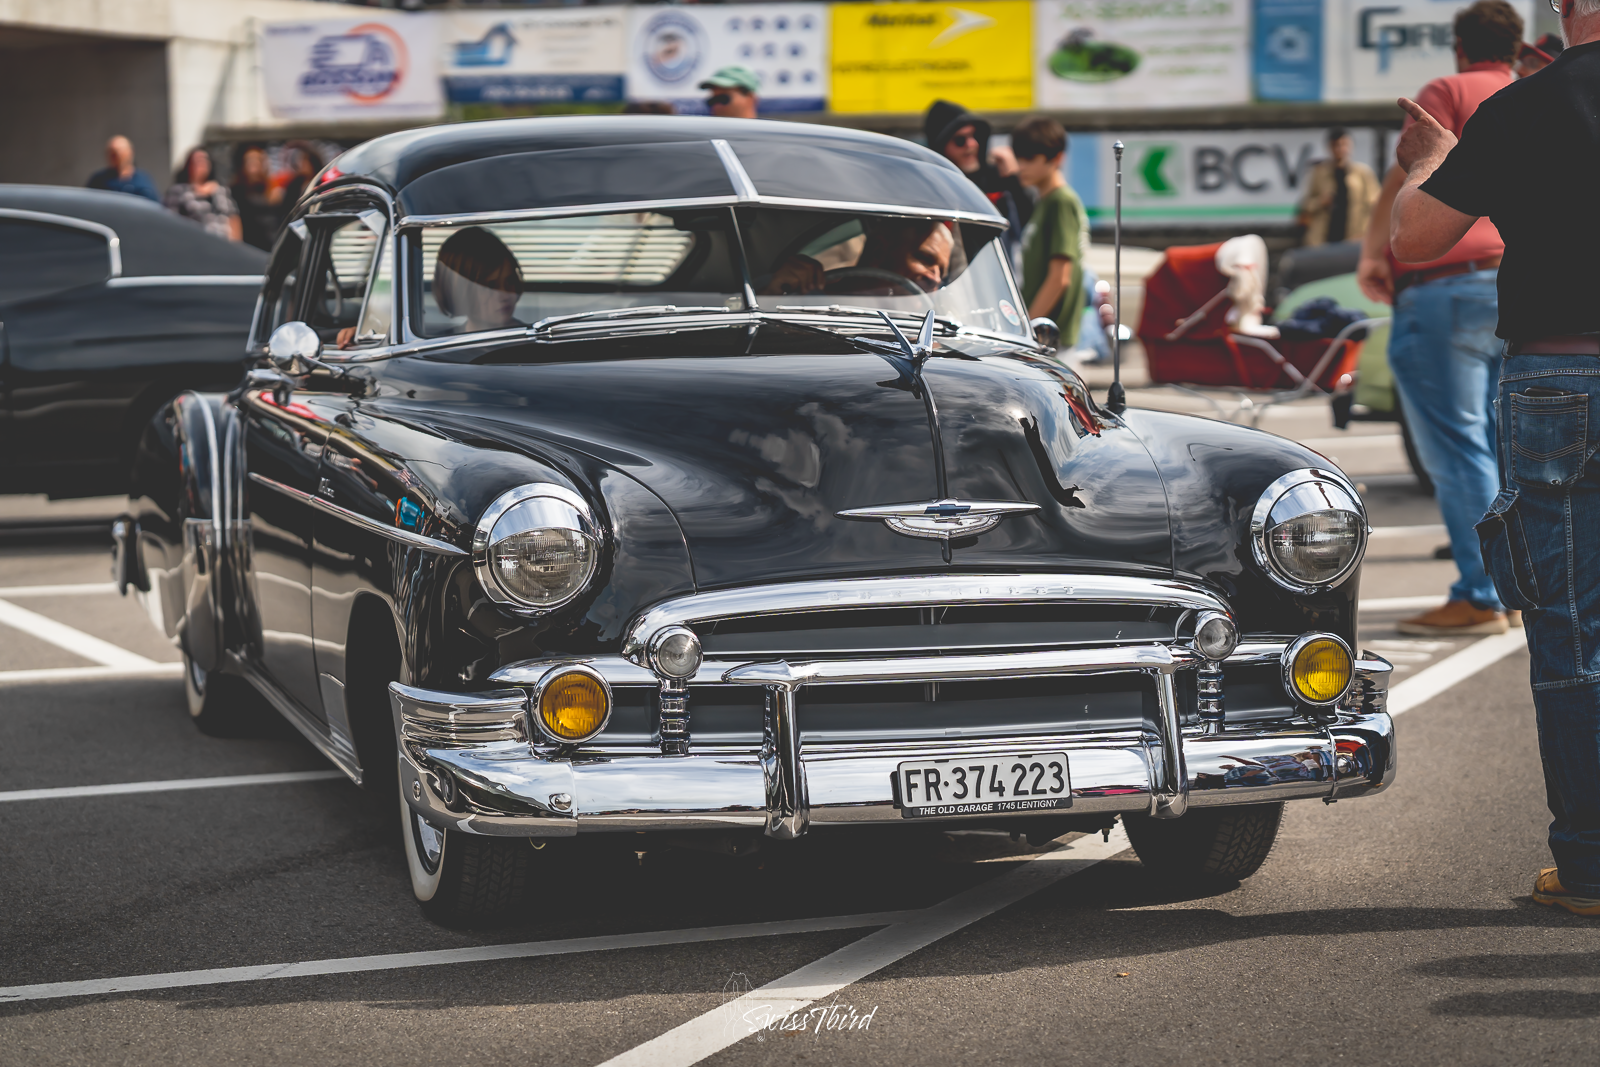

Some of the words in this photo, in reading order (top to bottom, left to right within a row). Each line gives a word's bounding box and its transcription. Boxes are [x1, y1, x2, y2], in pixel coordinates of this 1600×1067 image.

[1193, 143, 1315, 193] BCV
[919, 807, 936, 815] THE
[937, 805, 955, 814] OLD
[957, 803, 993, 813] GARAGE
[998, 801, 1016, 810] 1745
[1017, 799, 1058, 809] LENTIGNY
